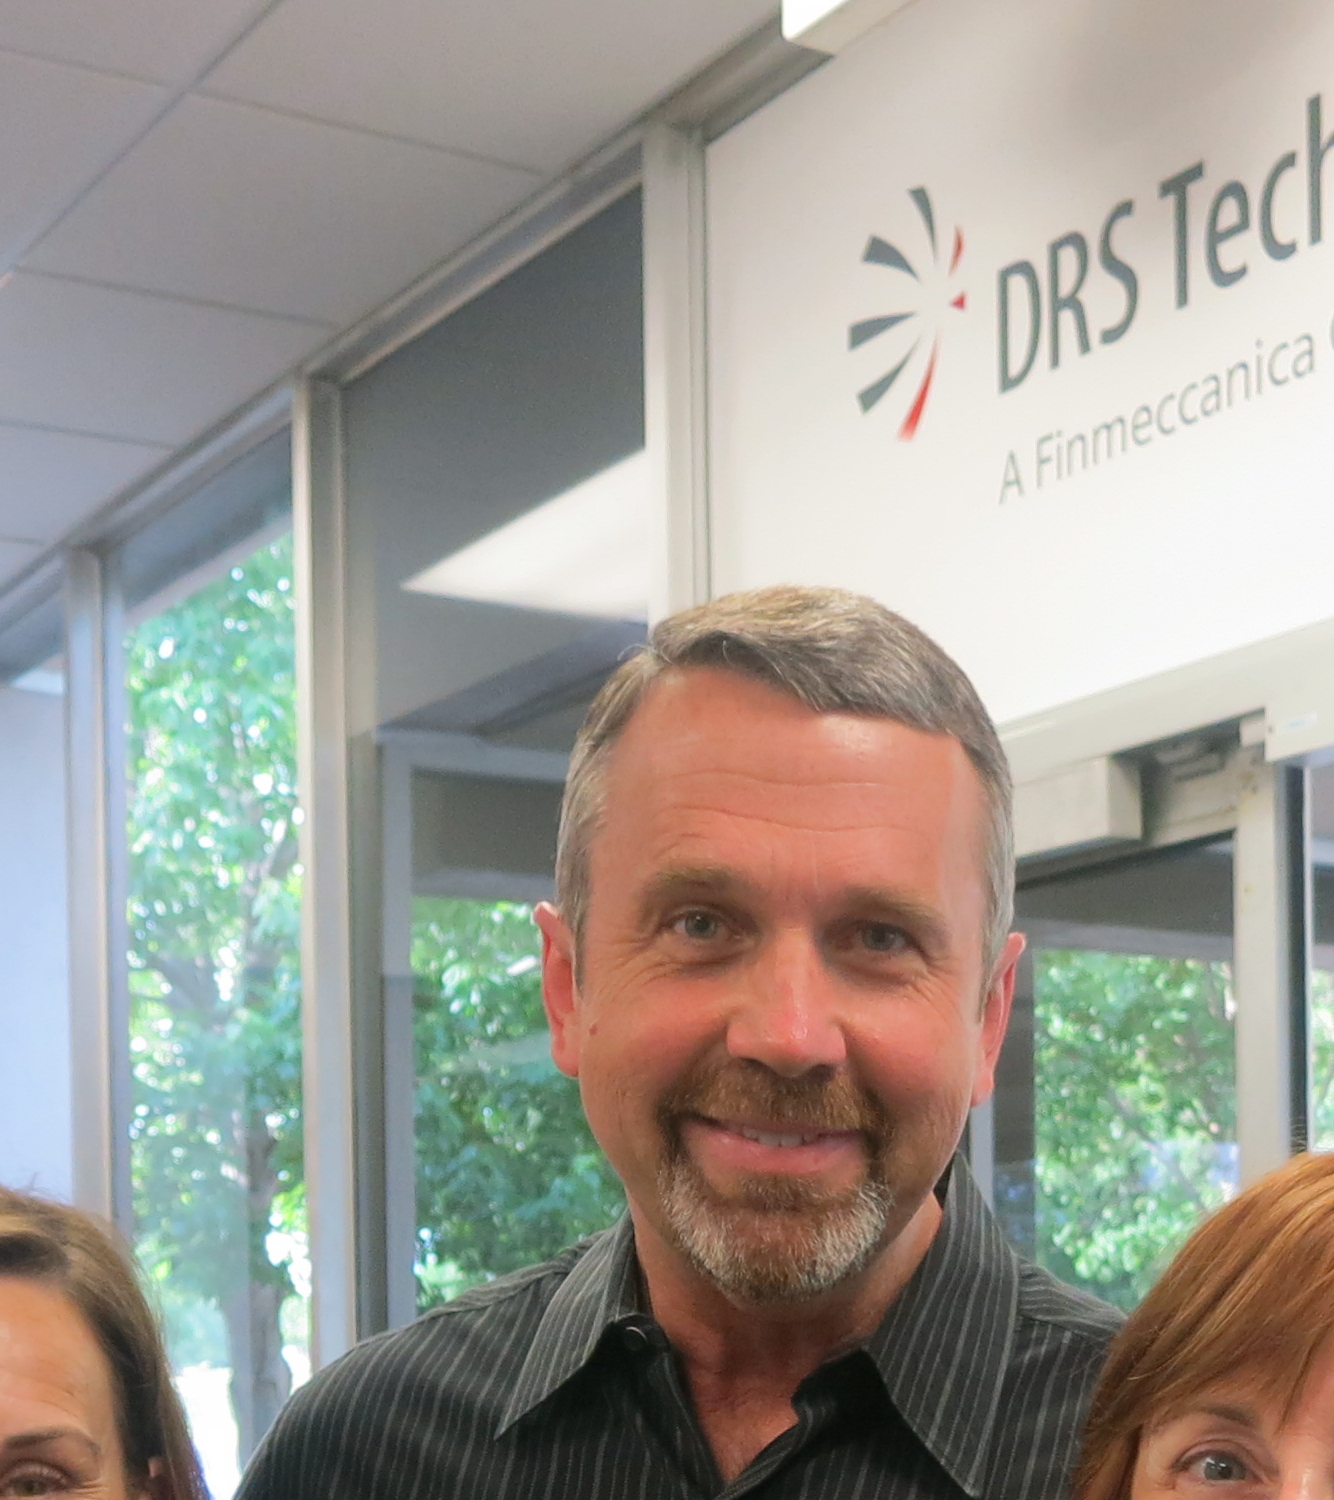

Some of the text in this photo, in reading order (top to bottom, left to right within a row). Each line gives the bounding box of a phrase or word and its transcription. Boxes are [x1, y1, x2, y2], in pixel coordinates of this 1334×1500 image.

[997, 199, 1138, 394] DRS
[998, 450, 1025, 505] A
[1035, 337, 1316, 490] Finmeccanica
